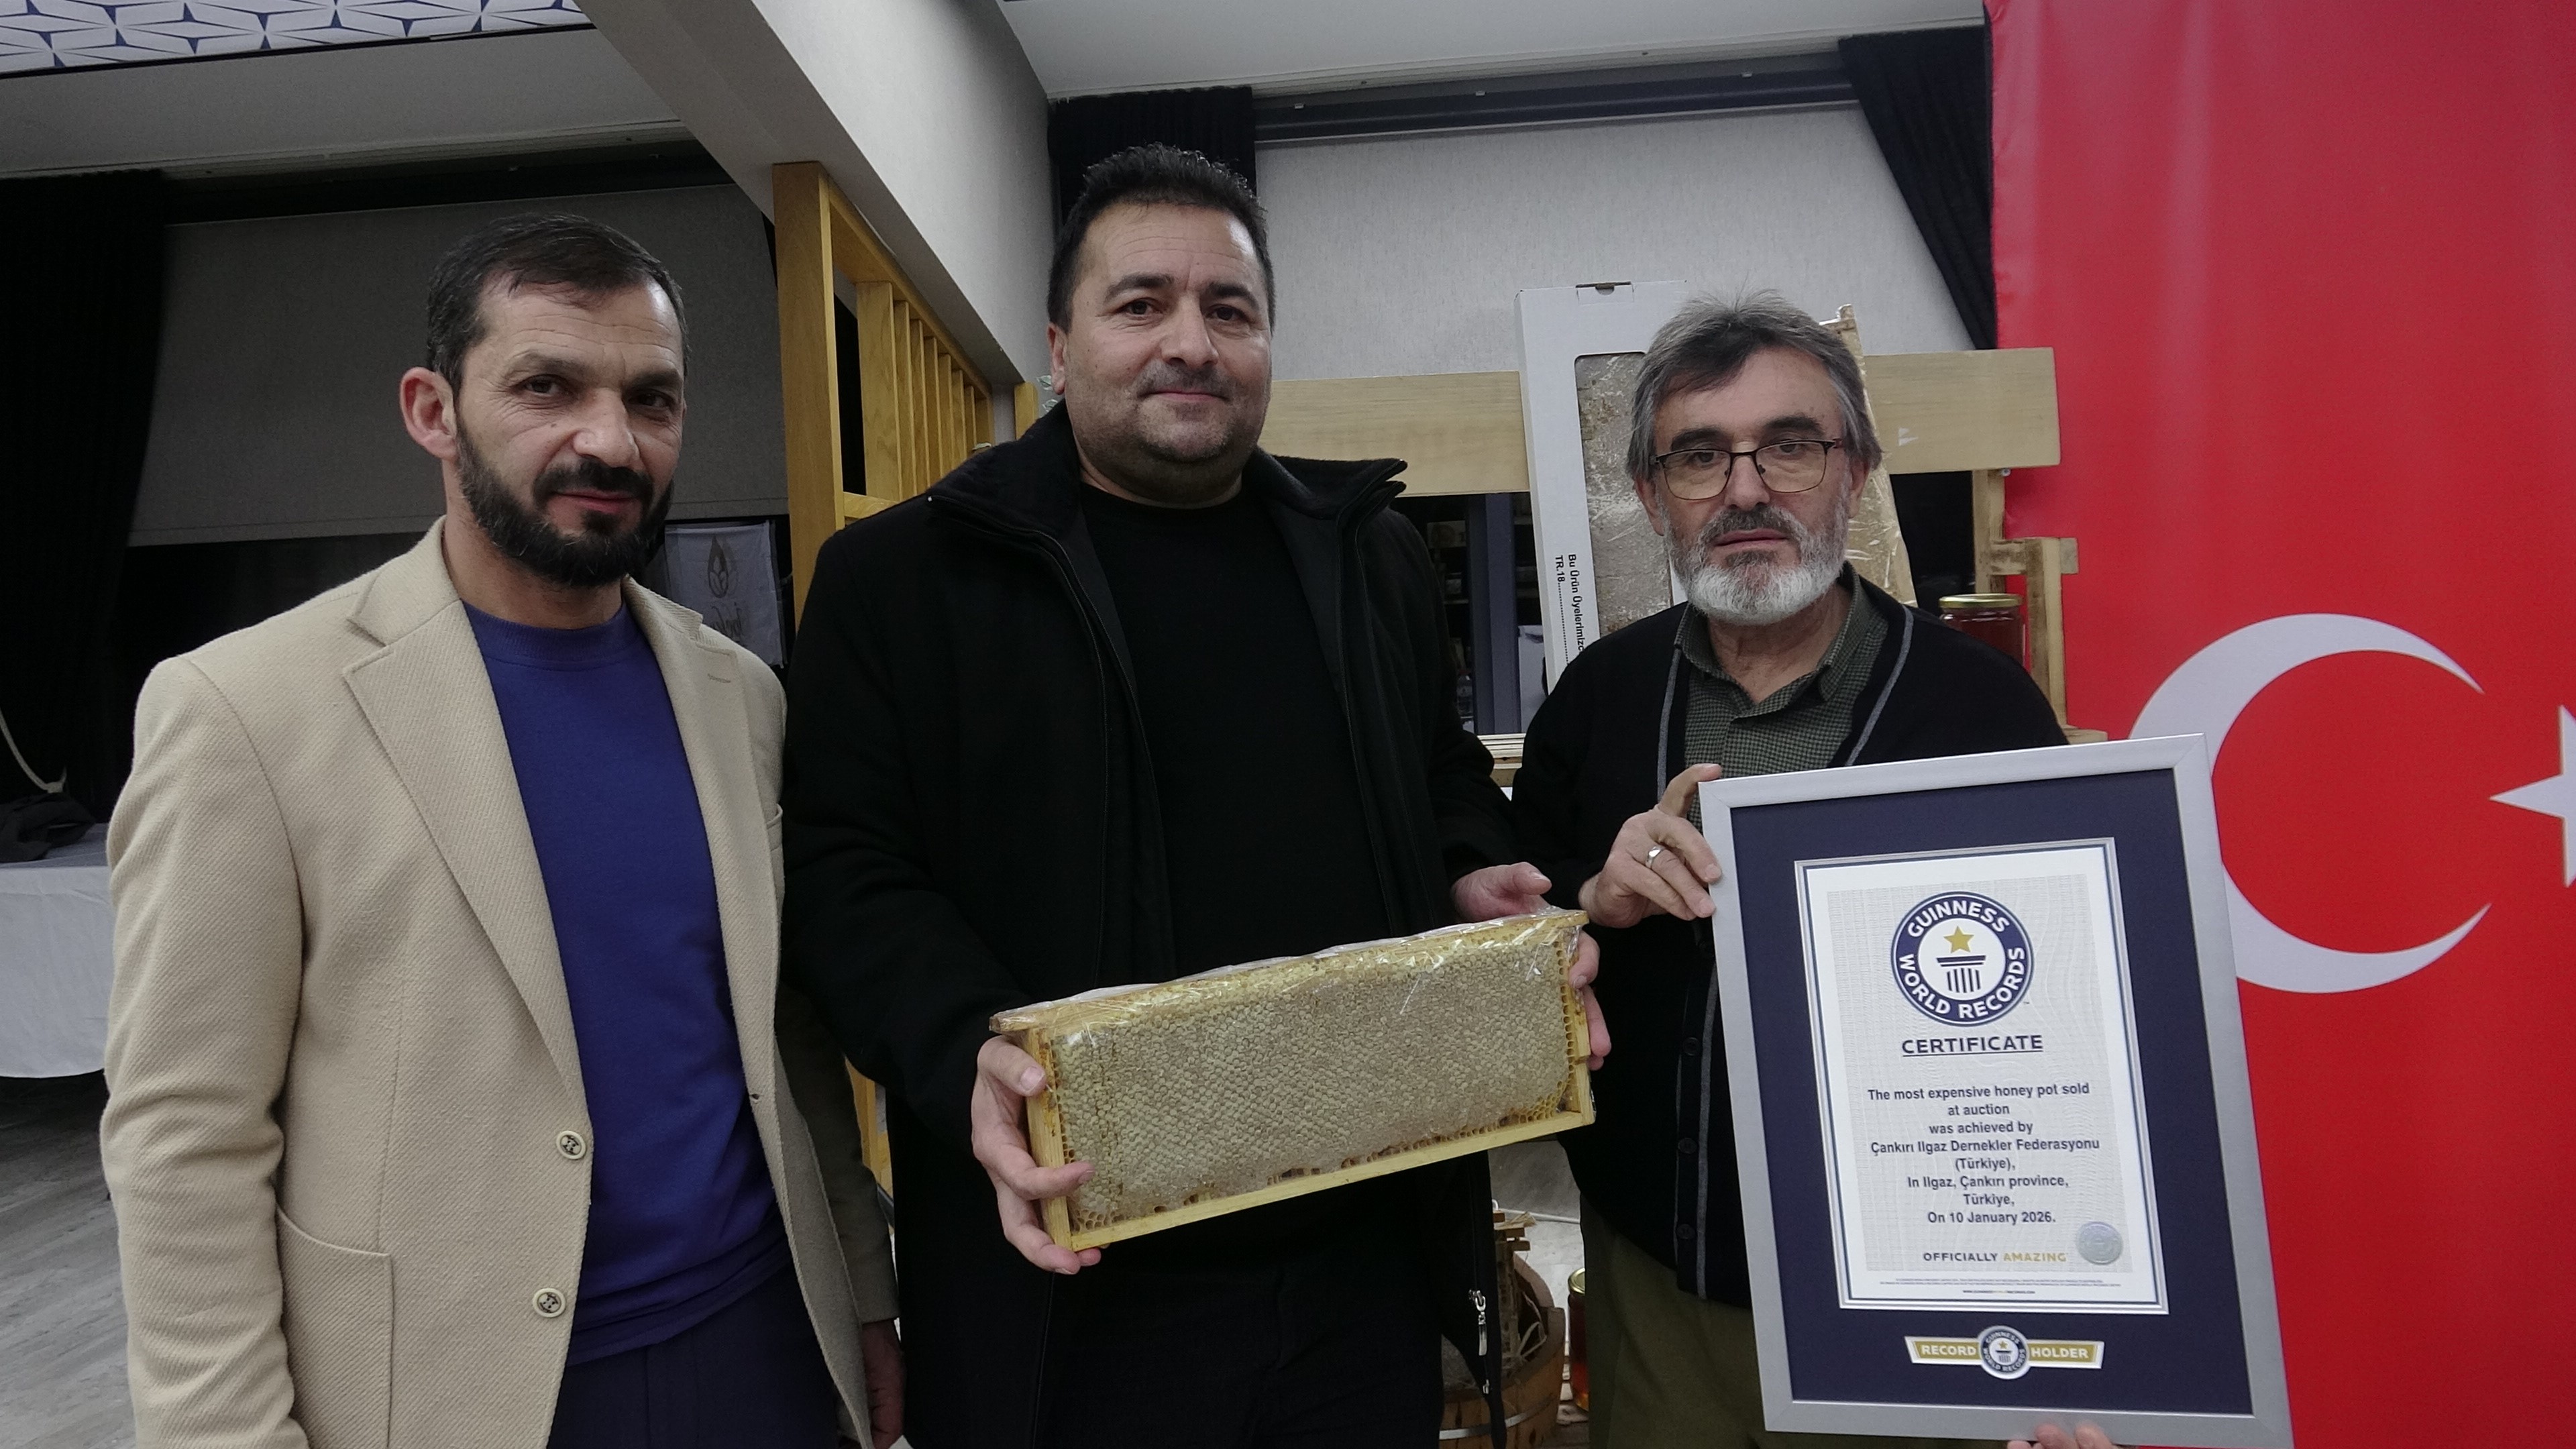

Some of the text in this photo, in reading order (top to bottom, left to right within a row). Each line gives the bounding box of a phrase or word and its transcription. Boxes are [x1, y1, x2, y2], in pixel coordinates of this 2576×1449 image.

[1568, 554, 1585, 653] Bu Ürün Üyelerimizc
[1908, 900, 2009, 938] GUINNESS
[1899, 947, 2025, 1018] WORLD RECORDS
[1901, 1034, 2043, 1054] CERTIFICATE
[1868, 1083, 2090, 1101] The most expensive honey pot sold
[1948, 1104, 2009, 1116] at auction
[1929, 1122, 2033, 1134] was achieved by
[1871, 1139, 2100, 1156] Çankırı Ilgaz Dernekler Federasyonu
[1955, 1158, 2015, 1172] (Türkiye),
[1908, 1175, 2068, 1190] In Ilgaz, Çankırı province,
[1964, 1193, 2015, 1206] Türkiye,
[1928, 1212, 2055, 1226] On 10 January 2026.
[1923, 1253, 2066, 1262] OFFICIALLY AMAZING
[1921, 1345, 2089, 1358] RECORD HOLDER
